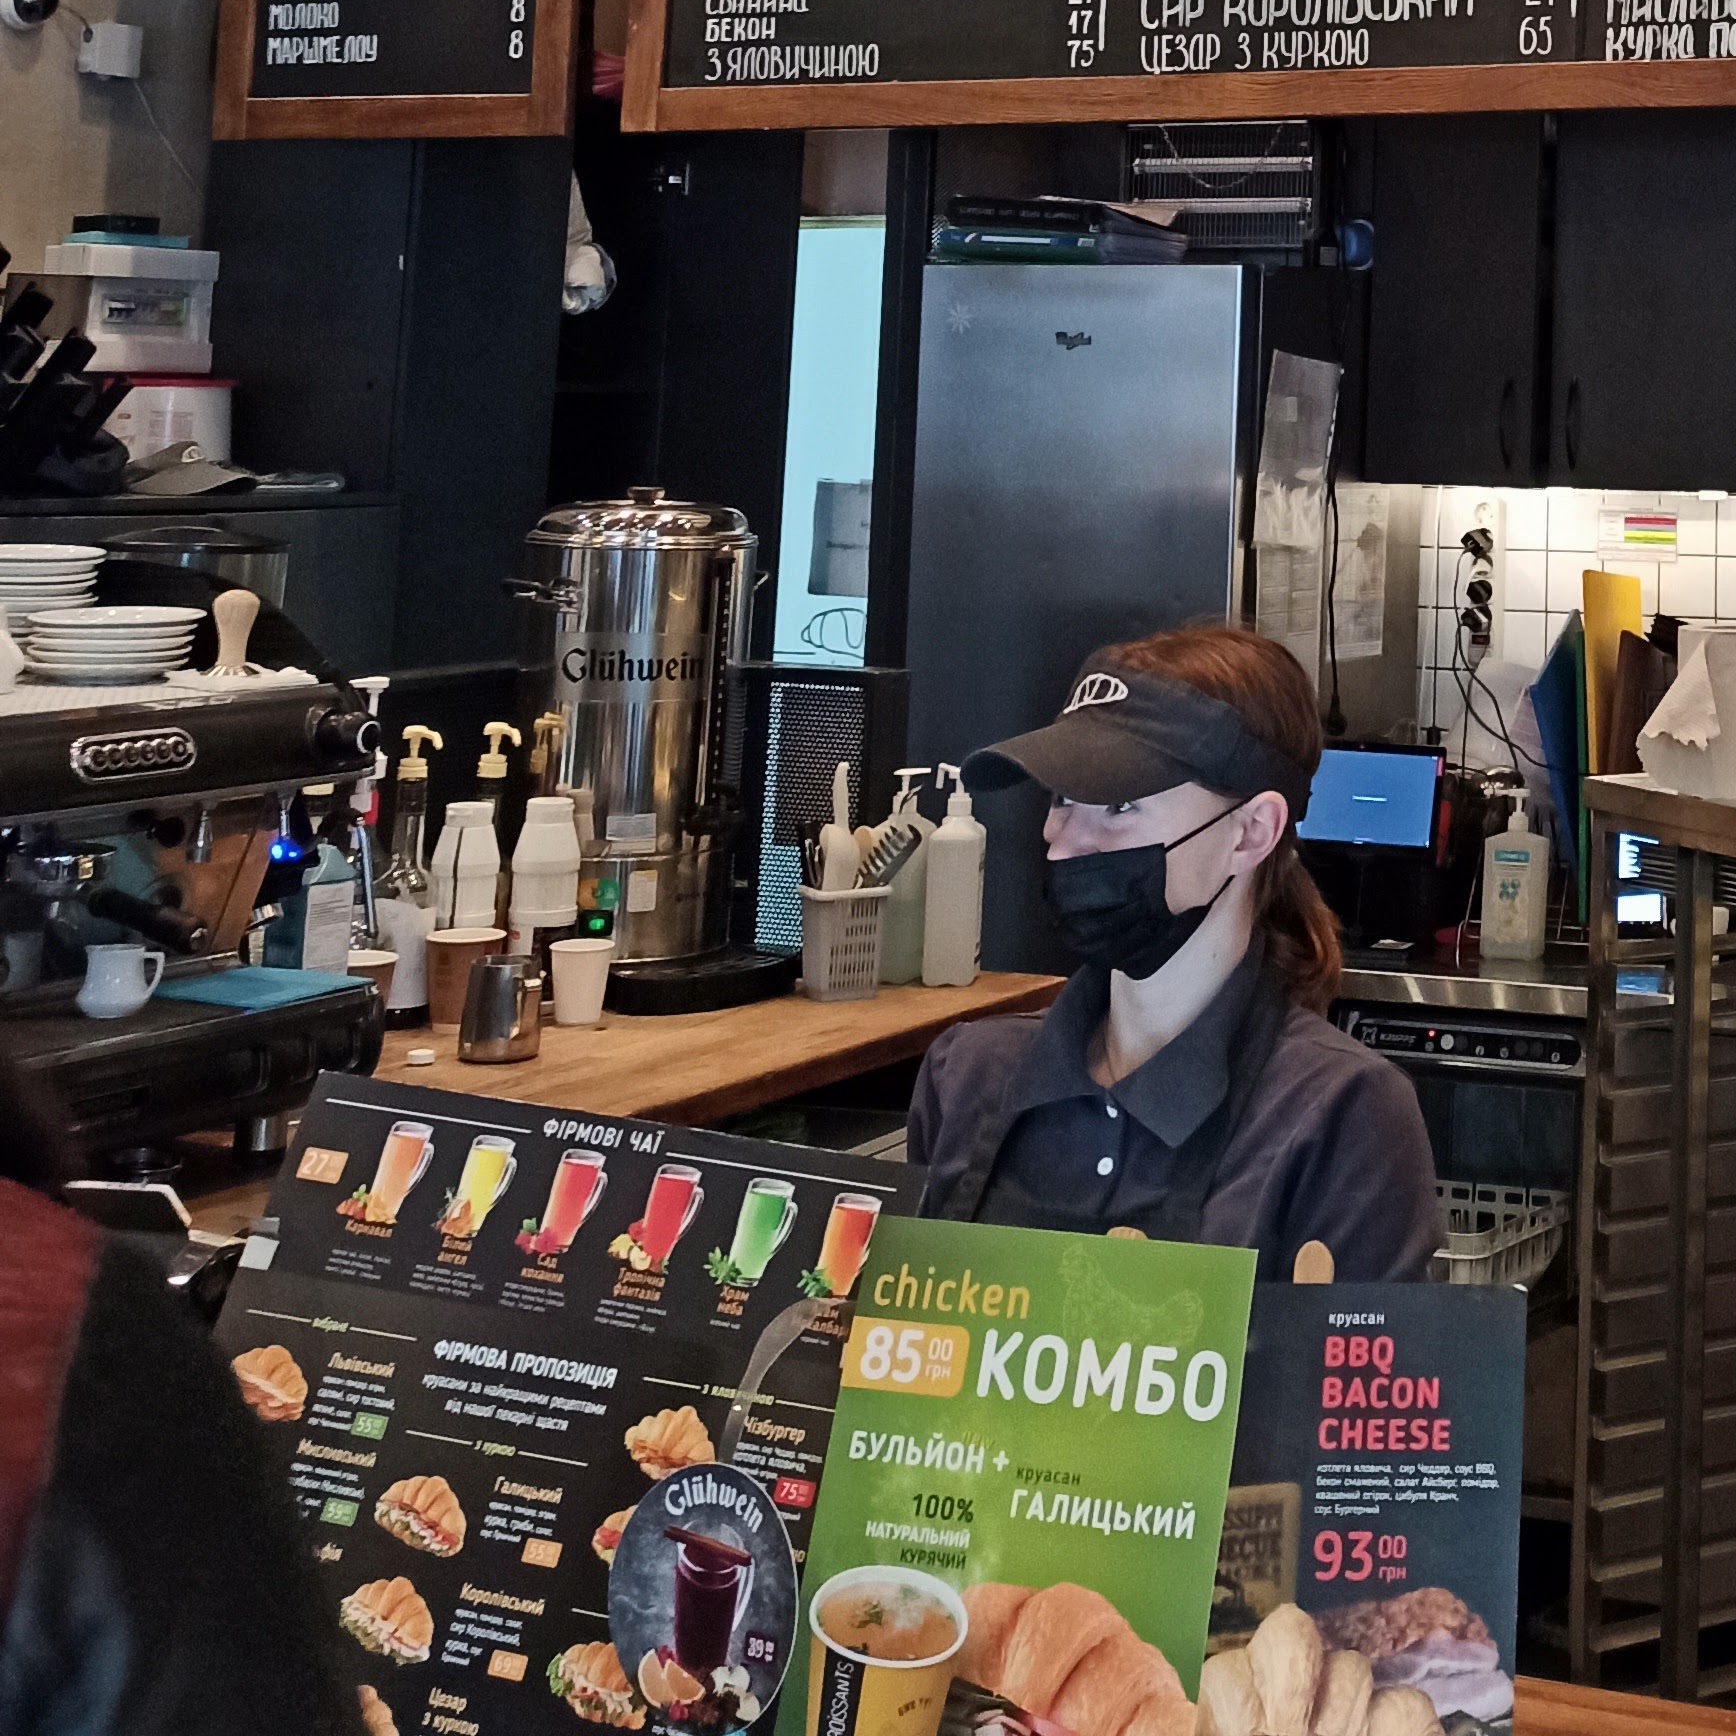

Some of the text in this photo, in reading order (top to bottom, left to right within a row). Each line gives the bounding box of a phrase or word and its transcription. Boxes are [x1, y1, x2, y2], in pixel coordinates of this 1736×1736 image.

[269, 1, 339, 30] МОЛОКО
[705, 16, 776, 42] БЕКОН
[1262, 29, 1369, 69] КУРКОЮ
[562, 647, 703, 683] Glühwein
[543, 1118, 665, 1155] ФІРМОВІ ЧАЇ
[873, 1263, 1031, 1319] chicken
[1328, 1312, 1385, 1327] круасан
[433, 1339, 618, 1389] ФІРМОВА ПРОПОЗИЦІЯ
[859, 1325, 953, 1384] 85 00
[1324, 1335, 1394, 1375] BBQ
[976, 1328, 1228, 1422] КОМБО
[1321, 1376, 1440, 1409] BACON
[849, 1429, 984, 1474] БУЛЬЙОН
[1318, 1417, 1451, 1452] CHEESE
[1015, 1465, 1081, 1486] круасан
[664, 1473, 764, 1534] Glühwein
[911, 1493, 974, 1523] 100%
[1009, 1488, 1196, 1540] ГАЛИЦЬКИЙ
[865, 1520, 970, 1549] НАТУРАЛЬНИЙ
[900, 1547, 967, 1570] КУРЯЧИЙ
[1313, 1530, 1374, 1582] 93
[1378, 1535, 1408, 1560] 00
